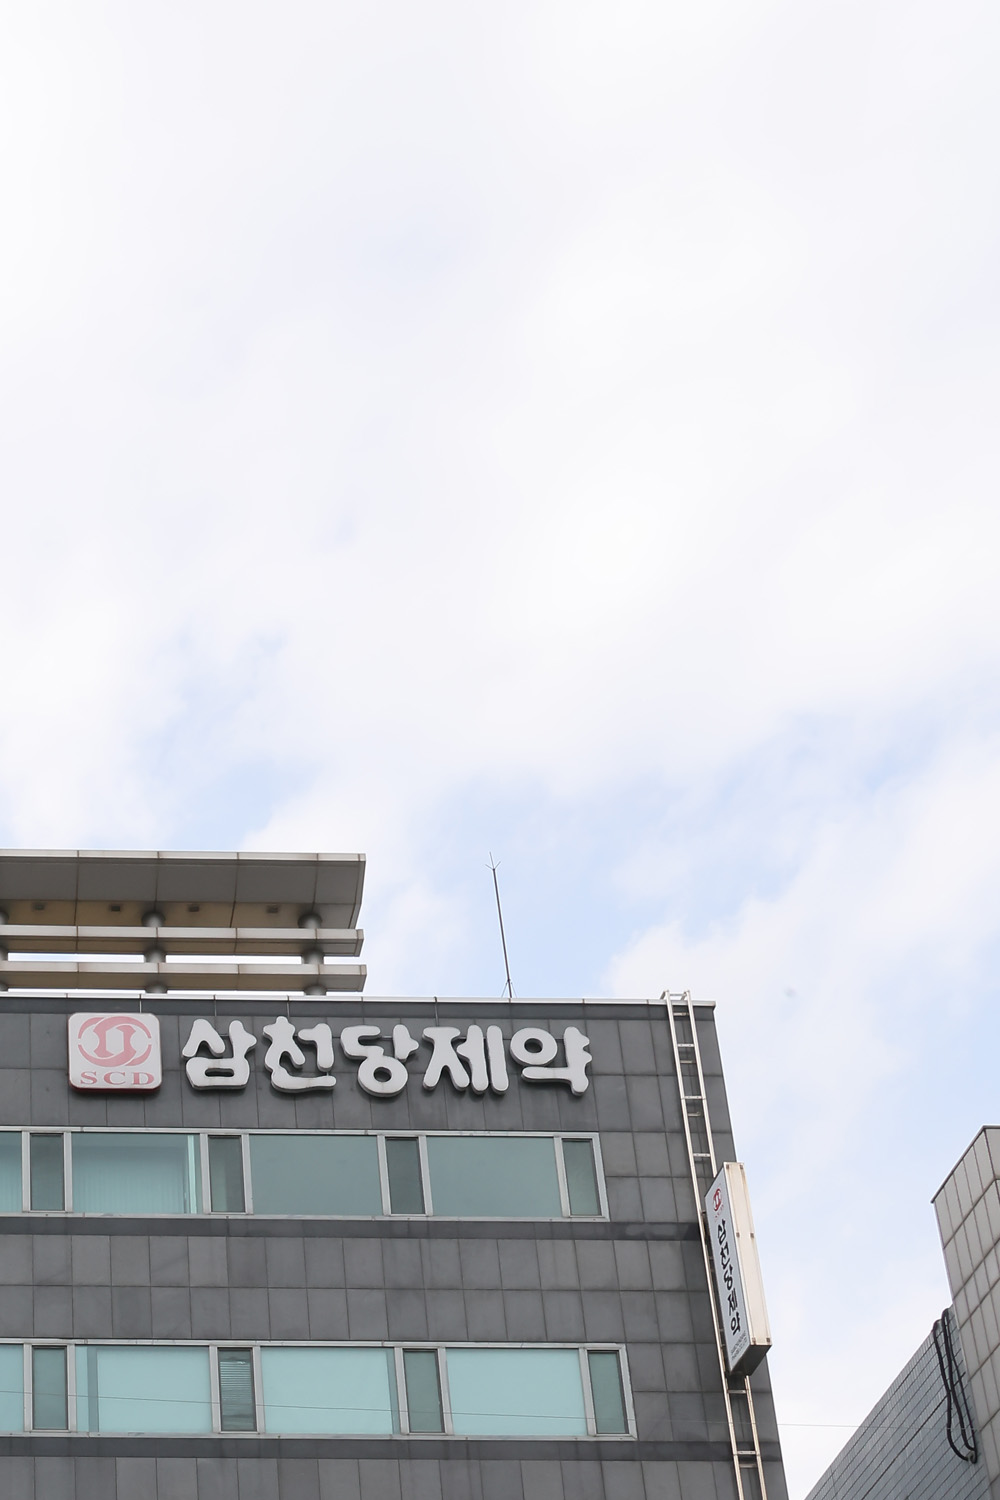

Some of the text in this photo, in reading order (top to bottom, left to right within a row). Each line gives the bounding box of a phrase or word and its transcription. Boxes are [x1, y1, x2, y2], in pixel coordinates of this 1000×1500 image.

[80, 1071, 155, 1085] SCD
[182, 1016, 592, 1098] 삼천당제약
[717, 1219, 741, 1336] 삼천당제약
